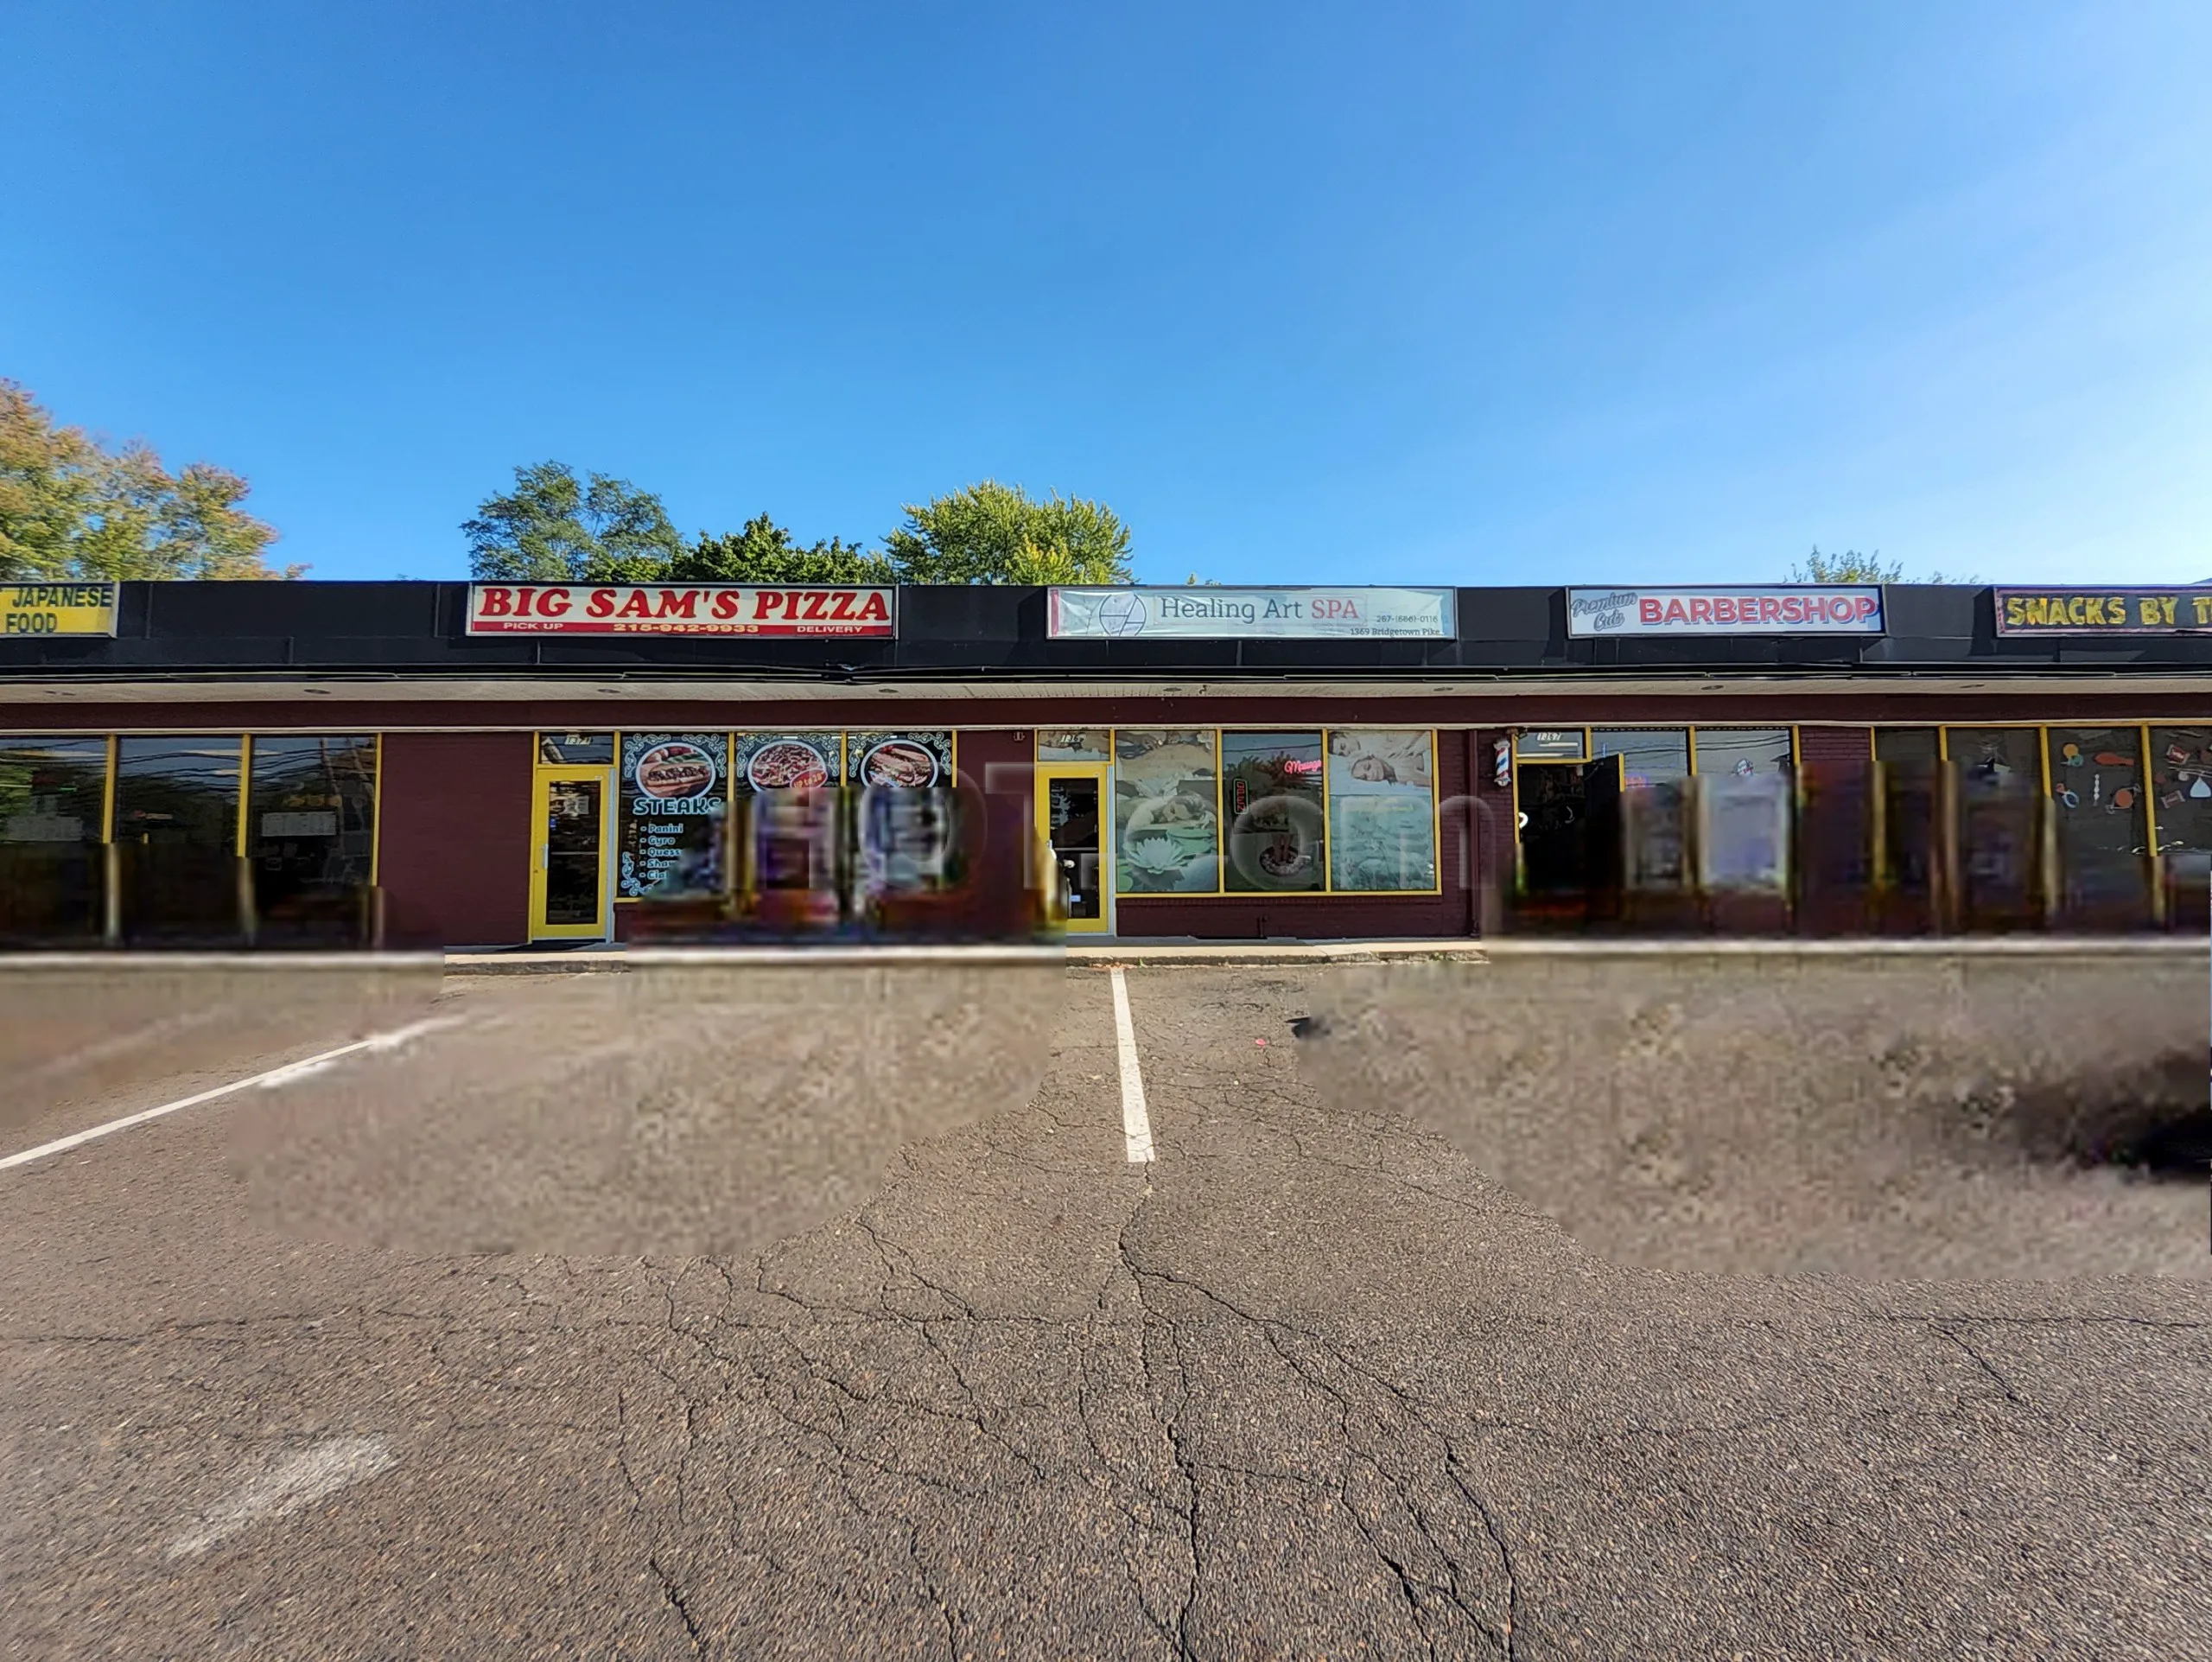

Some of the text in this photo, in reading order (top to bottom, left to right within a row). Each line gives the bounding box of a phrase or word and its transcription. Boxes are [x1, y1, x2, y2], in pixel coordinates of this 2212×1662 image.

[12, 588, 112, 608] JAPANESE
[479, 588, 890, 621] BIG SAM'S PIZZA
[1571, 592, 1638, 618] Premium
[1161, 597, 1360, 624] Healing Art SPA
[1593, 609, 1626, 632] Cuts
[1638, 595, 1881, 626] BARBERSHOP
[2005, 596, 2126, 626] SNACKS
[2138, 596, 2179, 625] BY
[6, 612, 58, 634] FOOD
[503, 621, 538, 630] PICK
[613, 622, 759, 633] 215-942-9933
[796, 625, 863, 634] DELIVERY
[1371, 627, 1421, 638] Bridgetown
[1421, 627, 1440, 636] Pike
[632, 797, 721, 815] STEAKS
[648, 823, 684, 833] Panini
[648, 835, 677, 847] Gyro
